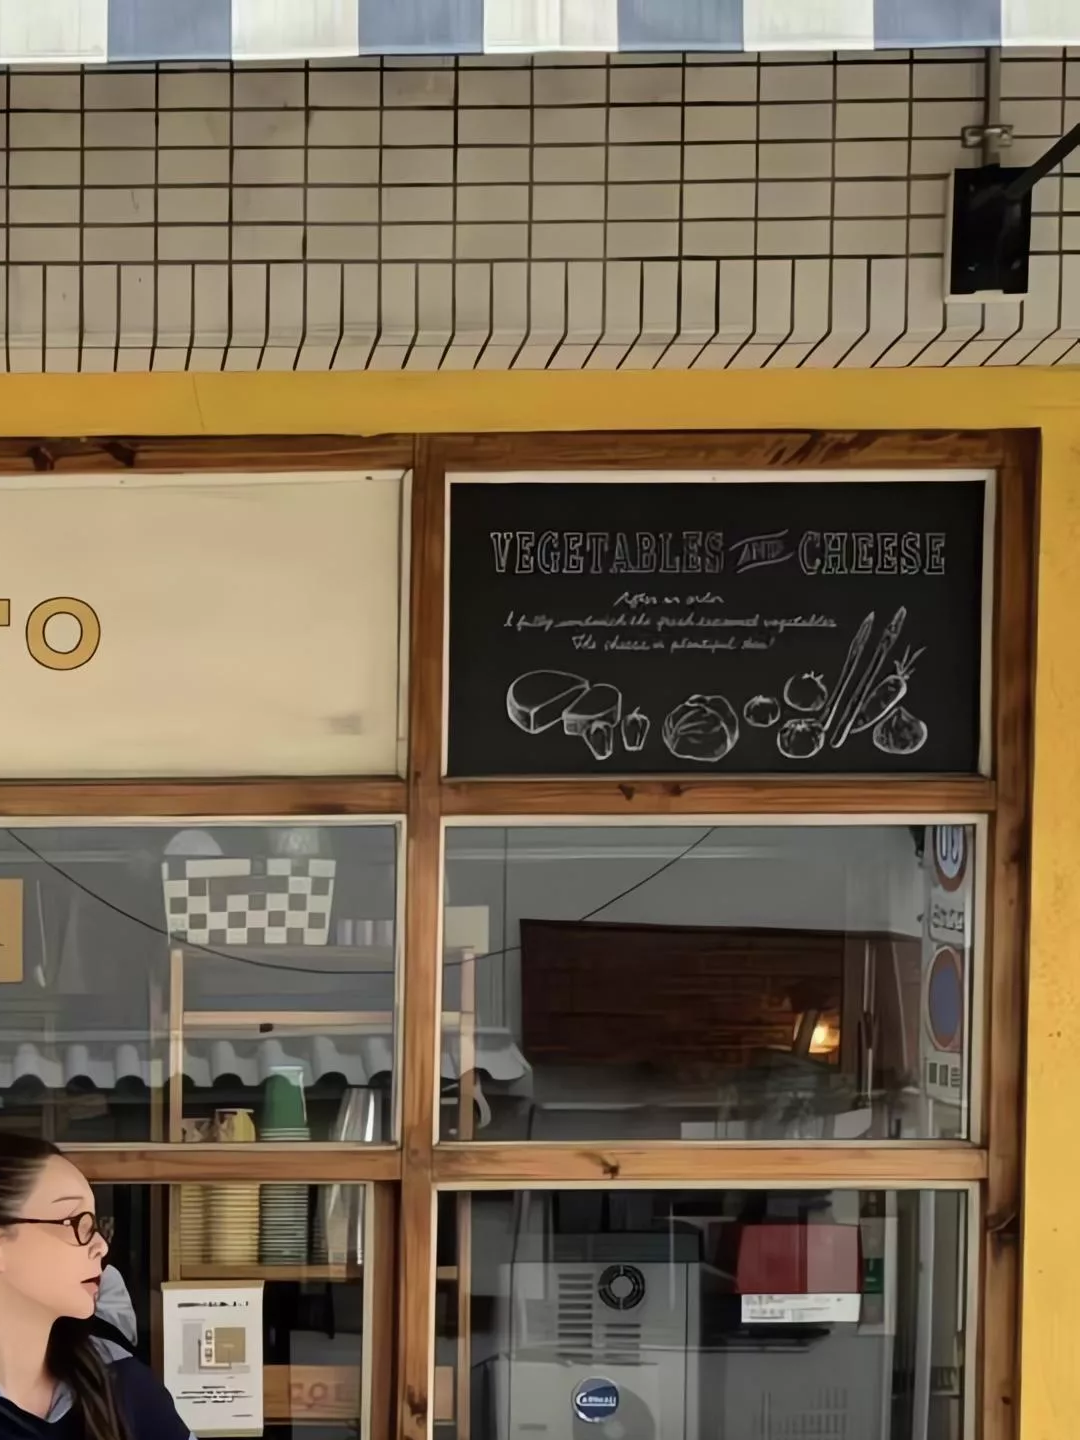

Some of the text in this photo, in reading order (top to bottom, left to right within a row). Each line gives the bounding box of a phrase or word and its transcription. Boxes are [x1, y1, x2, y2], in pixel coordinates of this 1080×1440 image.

[490, 530, 947, 575] VEGETABLES AND CHEESE
